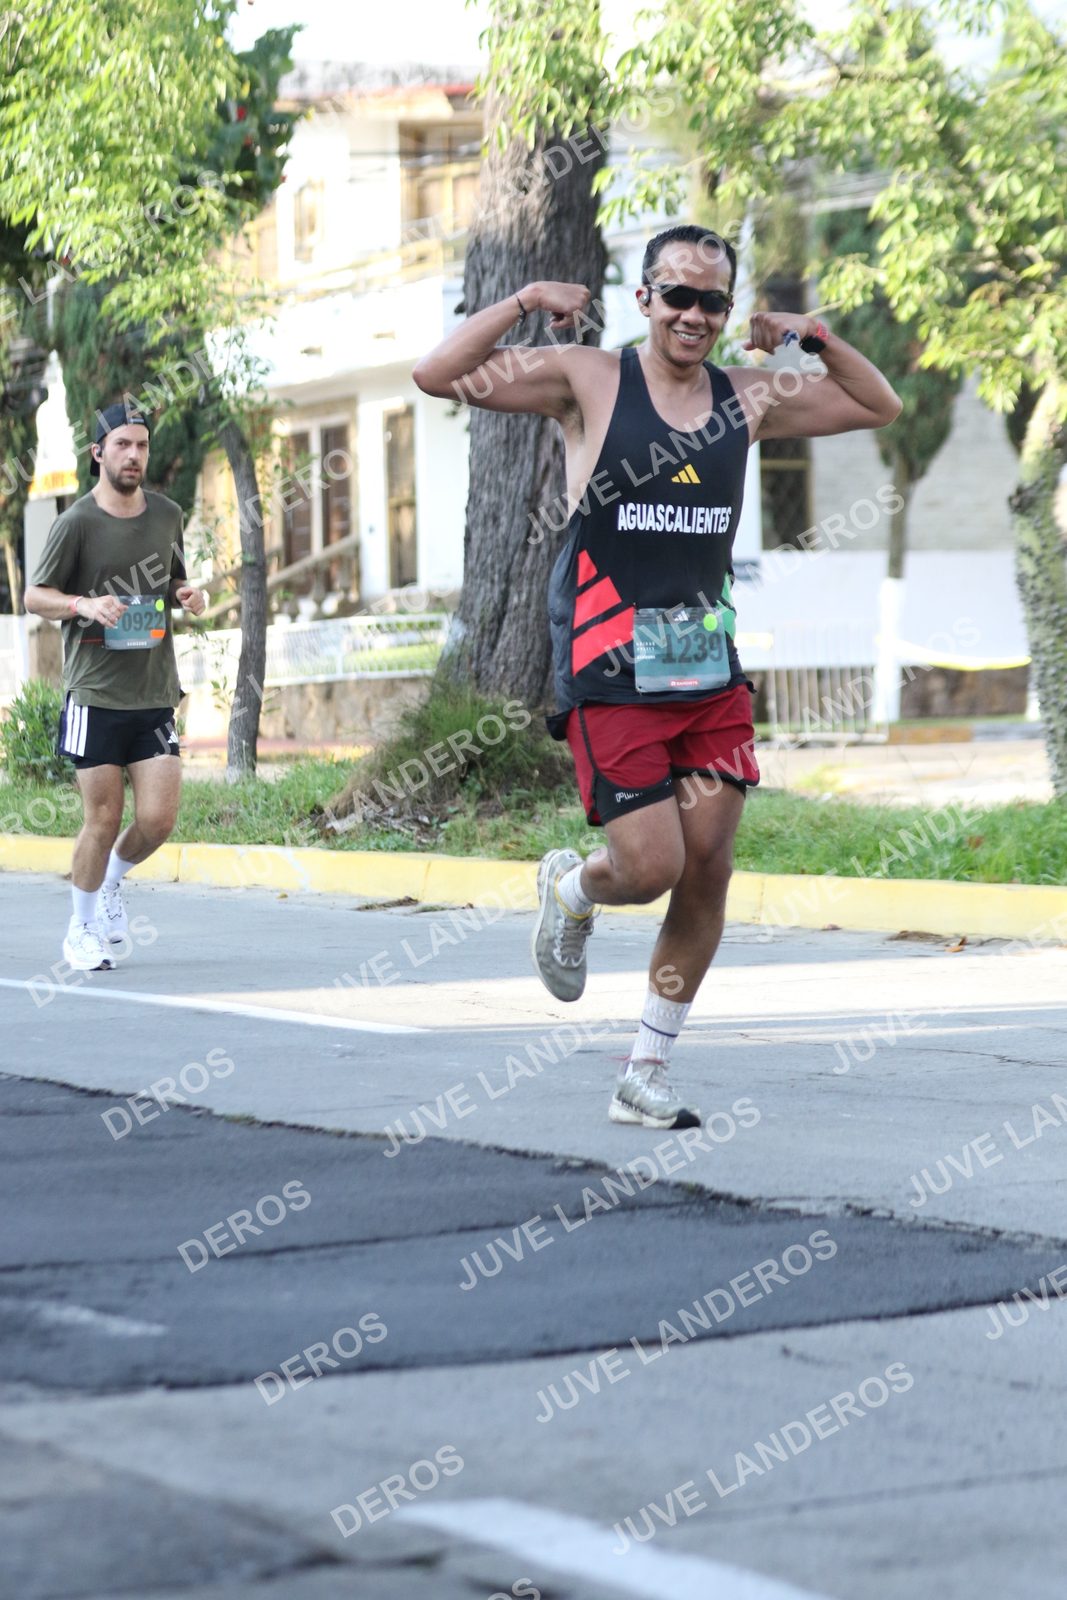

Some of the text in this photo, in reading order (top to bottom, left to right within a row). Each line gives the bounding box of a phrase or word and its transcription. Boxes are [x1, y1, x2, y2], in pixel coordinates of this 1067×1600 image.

[618, 502, 731, 534] AGUASCALIENTES
[122, 611, 164, 632] 0922
[662, 632, 724, 664] 1239
